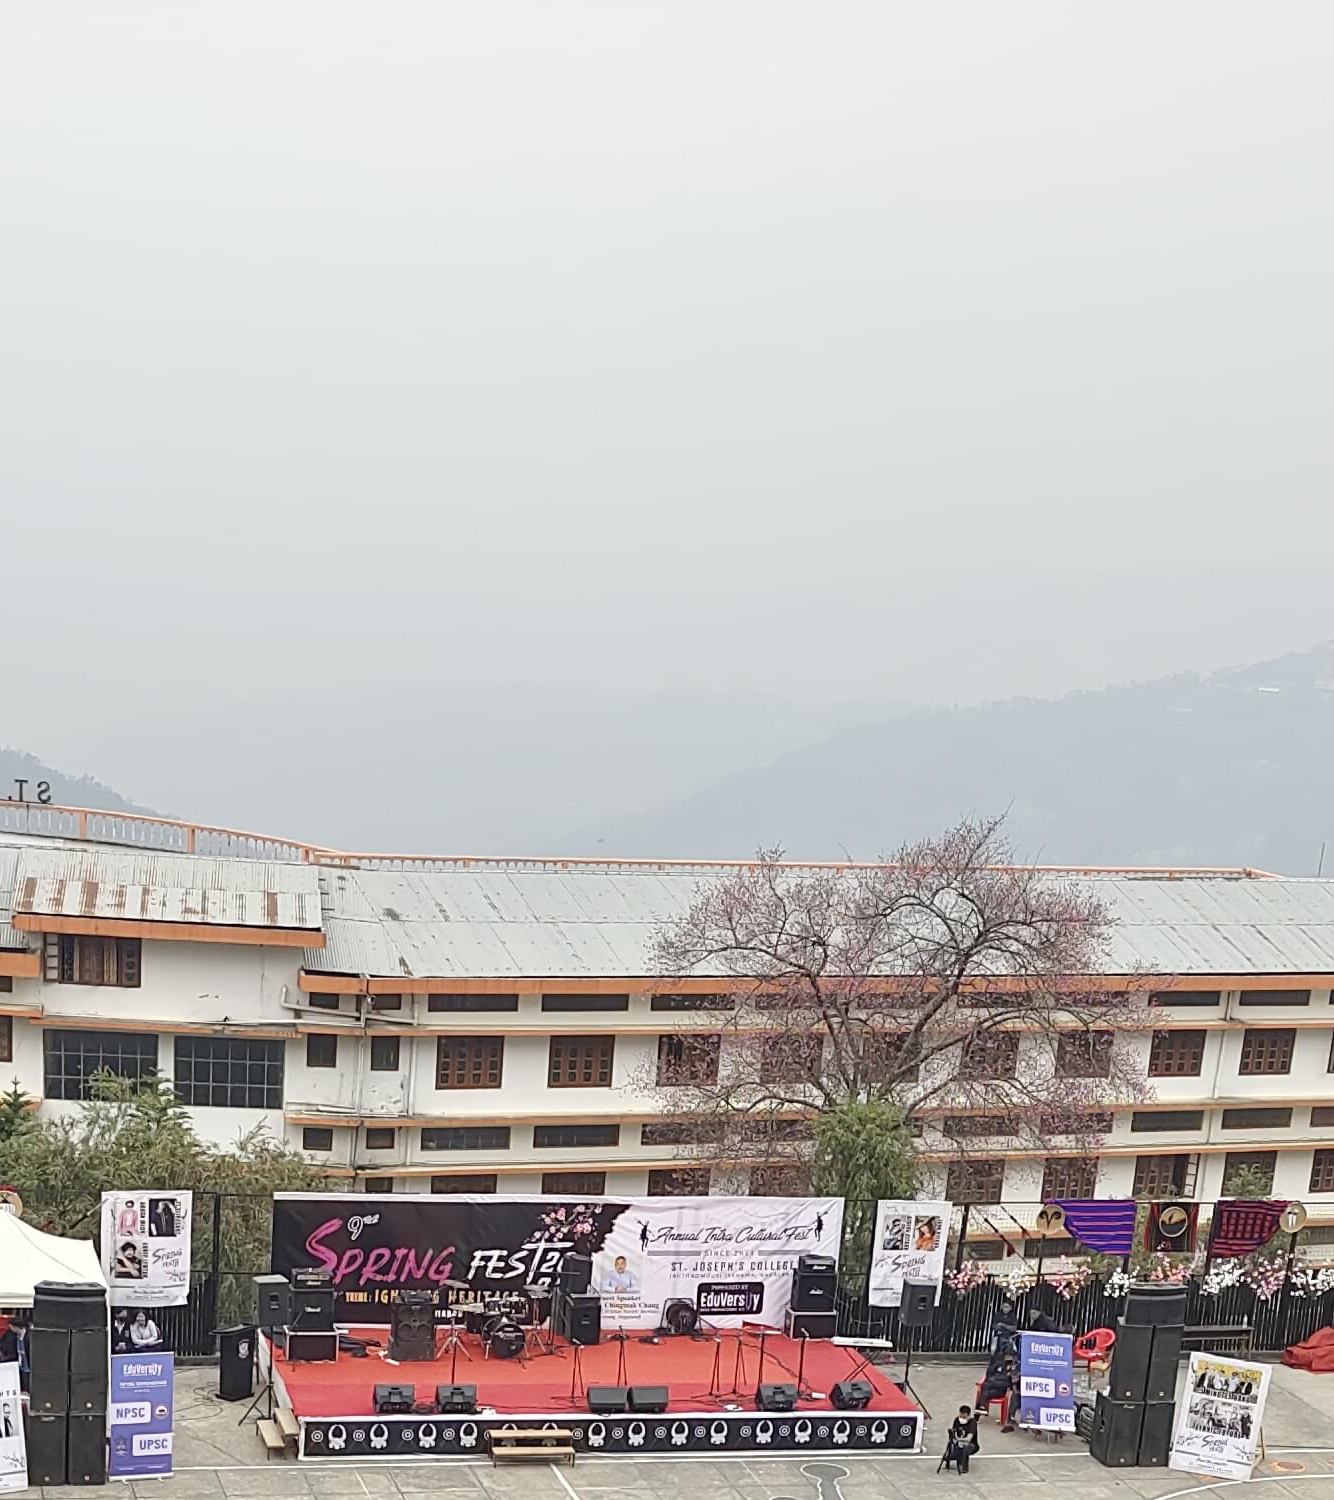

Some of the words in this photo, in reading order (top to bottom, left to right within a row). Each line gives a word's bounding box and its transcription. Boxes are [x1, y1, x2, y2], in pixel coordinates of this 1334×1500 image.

[651, 1226, 700, 1244] Annual
[735, 1226, 784, 1244] Cultural
[782, 1225, 814, 1242] Fest
[305, 1217, 457, 1286] SPRING
[467, 1237, 575, 1285] FEST
[692, 1262, 745, 1272] JOSEPH'S
[750, 1261, 798, 1271] COLLEGE
[1025, 1381, 1050, 1393] NPSC
[116, 1407, 145, 1418] NPSC
[1046, 1413, 1071, 1424] UPSC
[139, 1439, 168, 1450] UPSC
